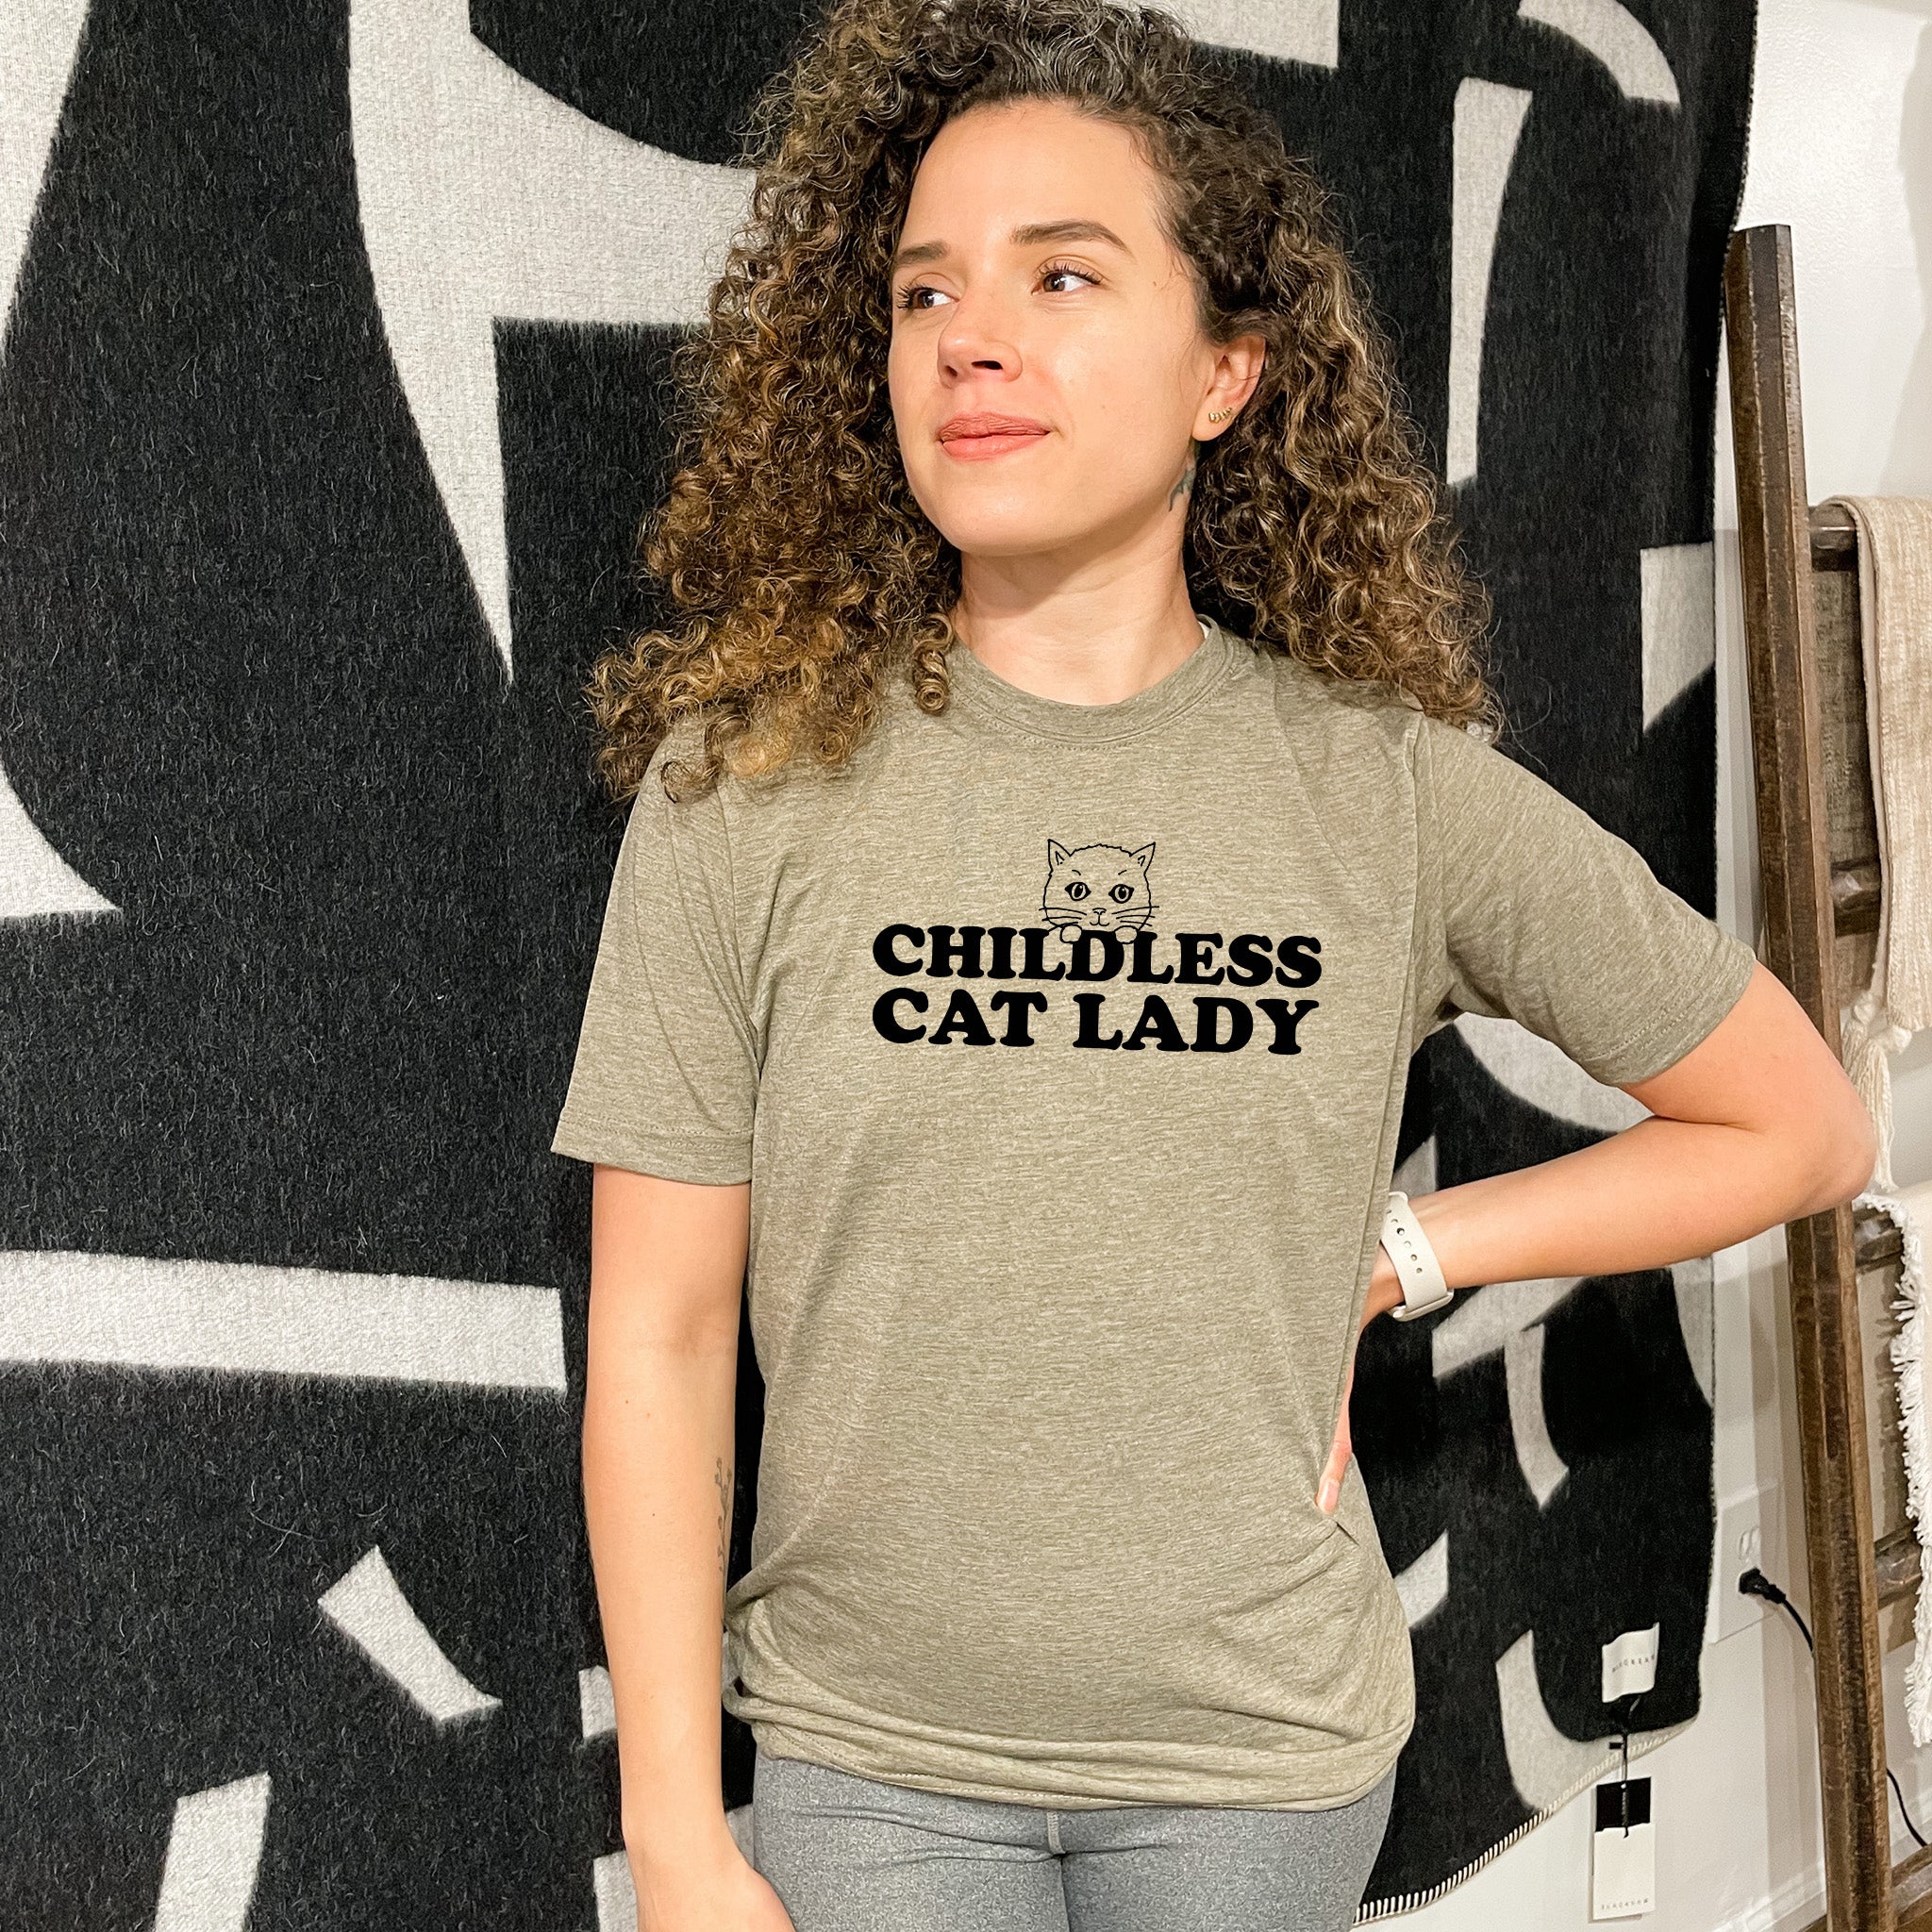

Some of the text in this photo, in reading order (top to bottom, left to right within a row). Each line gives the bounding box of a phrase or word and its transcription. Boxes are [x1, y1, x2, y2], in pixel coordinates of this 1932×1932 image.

[872, 923, 1323, 989] CHILDLESS
[872, 987, 1320, 1056] CAT LADY
